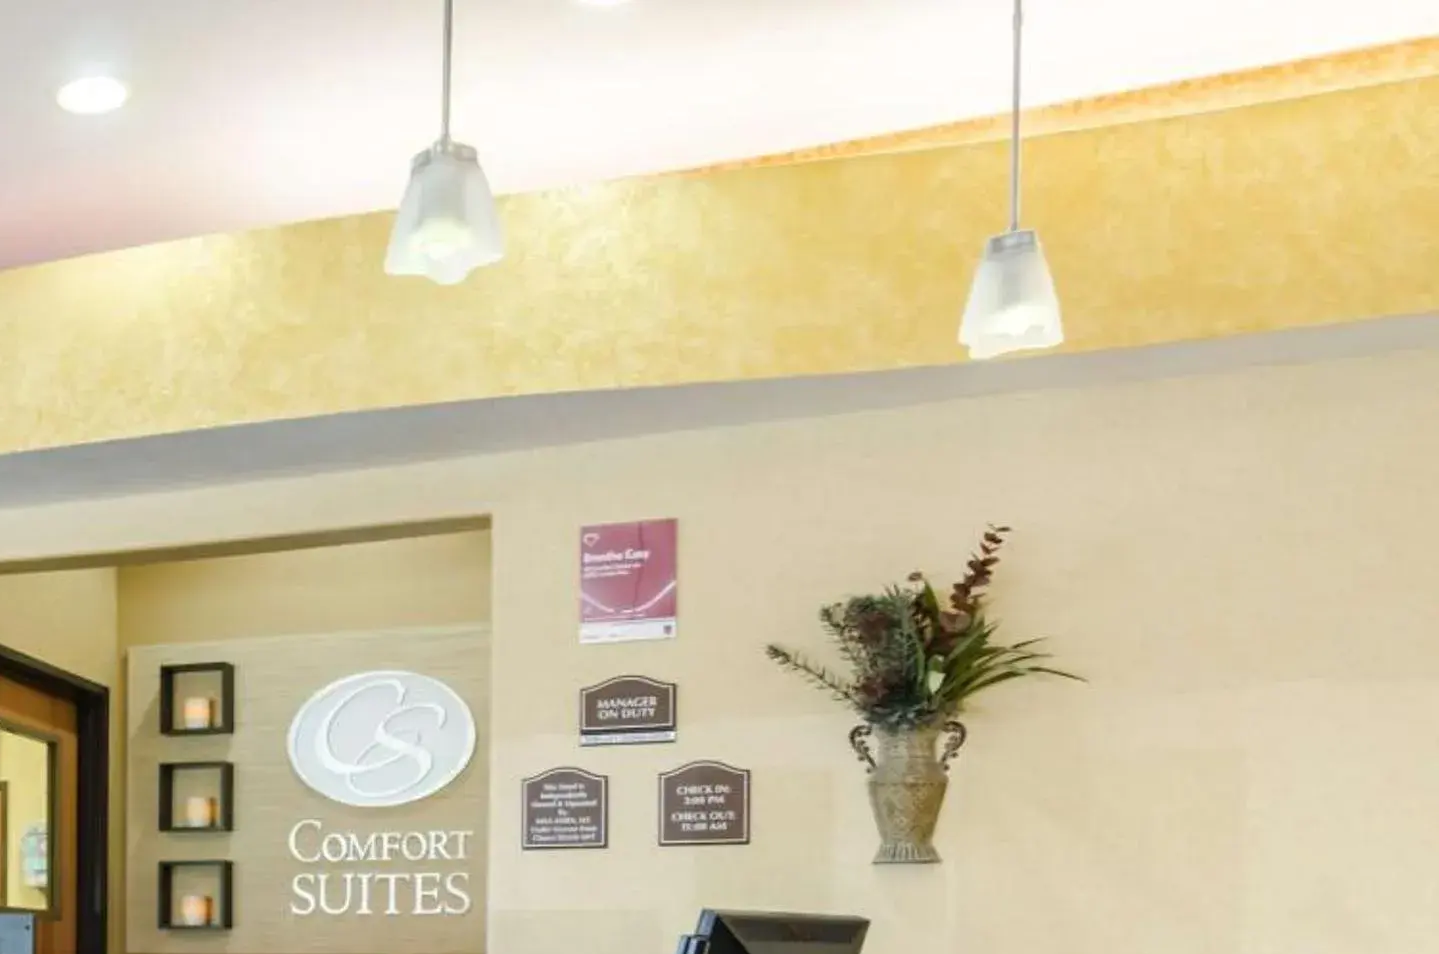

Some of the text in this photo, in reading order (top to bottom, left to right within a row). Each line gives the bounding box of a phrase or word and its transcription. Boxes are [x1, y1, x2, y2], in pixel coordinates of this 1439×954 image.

[597, 696, 657, 709] MANAGER
[597, 707, 656, 720] ON DUTY
[675, 785, 713, 796] CHECK
[707, 795, 725, 804] PM
[670, 811, 708, 823] CHECK
[708, 822, 728, 831] AM
[288, 818, 474, 864] COMFORT
[290, 872, 472, 916] SUITES
